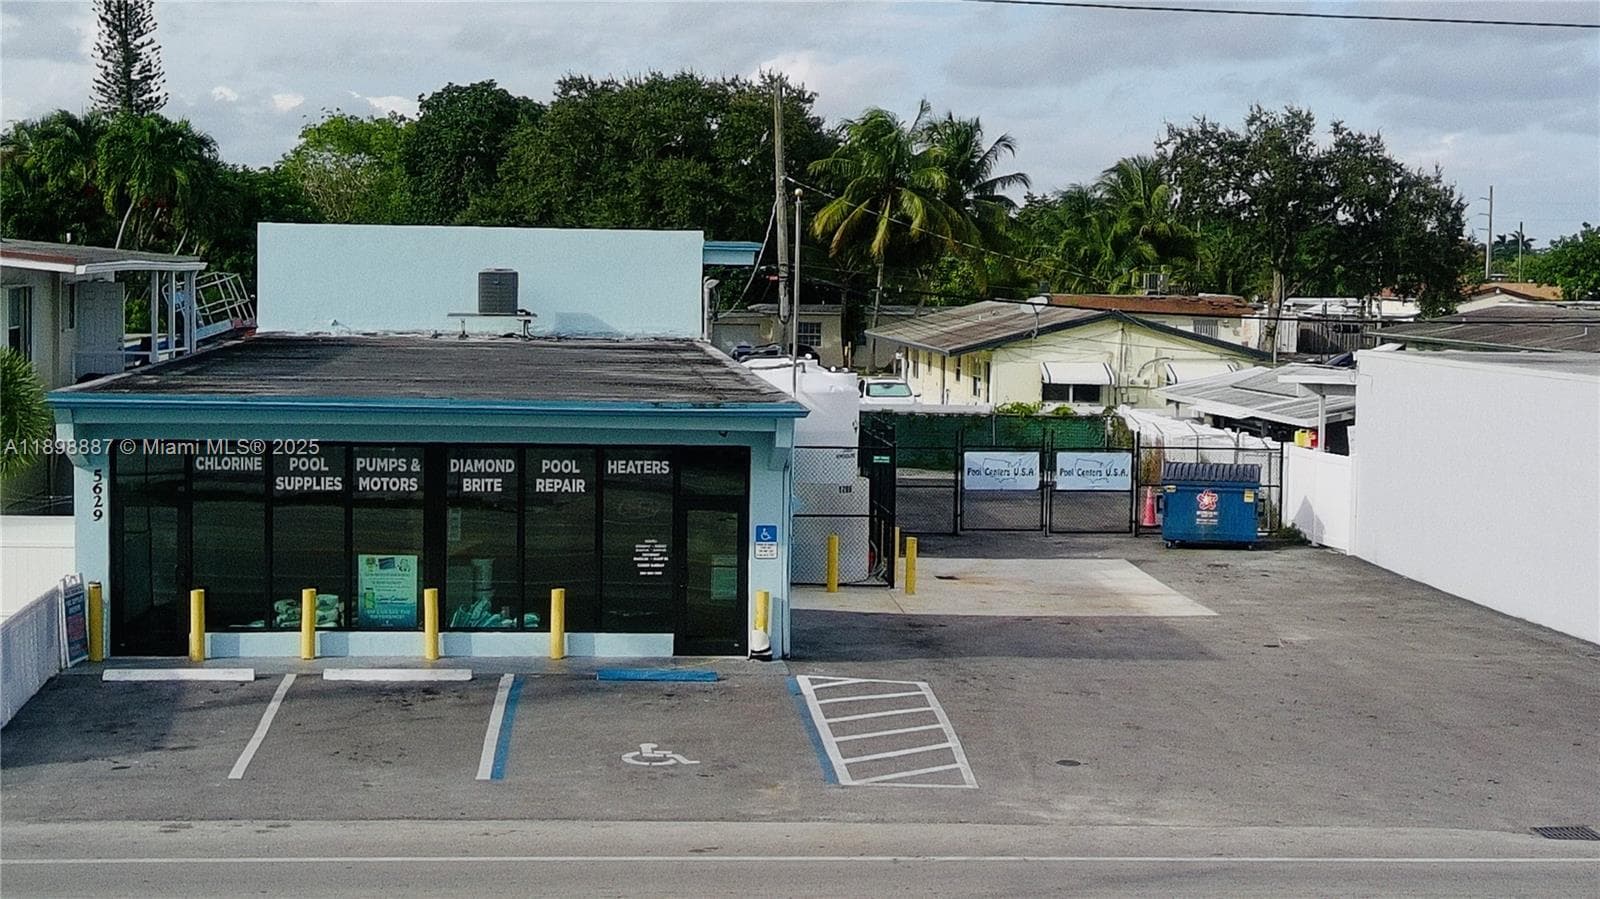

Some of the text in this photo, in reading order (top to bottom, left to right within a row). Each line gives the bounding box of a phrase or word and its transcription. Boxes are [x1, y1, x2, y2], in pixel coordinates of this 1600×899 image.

[195, 456, 263, 471] CHLORINE
[289, 457, 329, 471] POOL
[356, 457, 421, 472] PUMPS &
[450, 459, 515, 473] DIAMOND
[542, 459, 580, 474] POOL
[607, 460, 670, 474] HEATERS
[1060, 467, 1074, 477] Pool
[1077, 467, 1102, 477] Centers
[275, 476, 343, 491] SUPPLIES
[358, 477, 418, 491] MOTORS
[462, 478, 503, 492] BRITE
[536, 478, 586, 493] REPAIR
[92, 469, 103, 521] 5629
